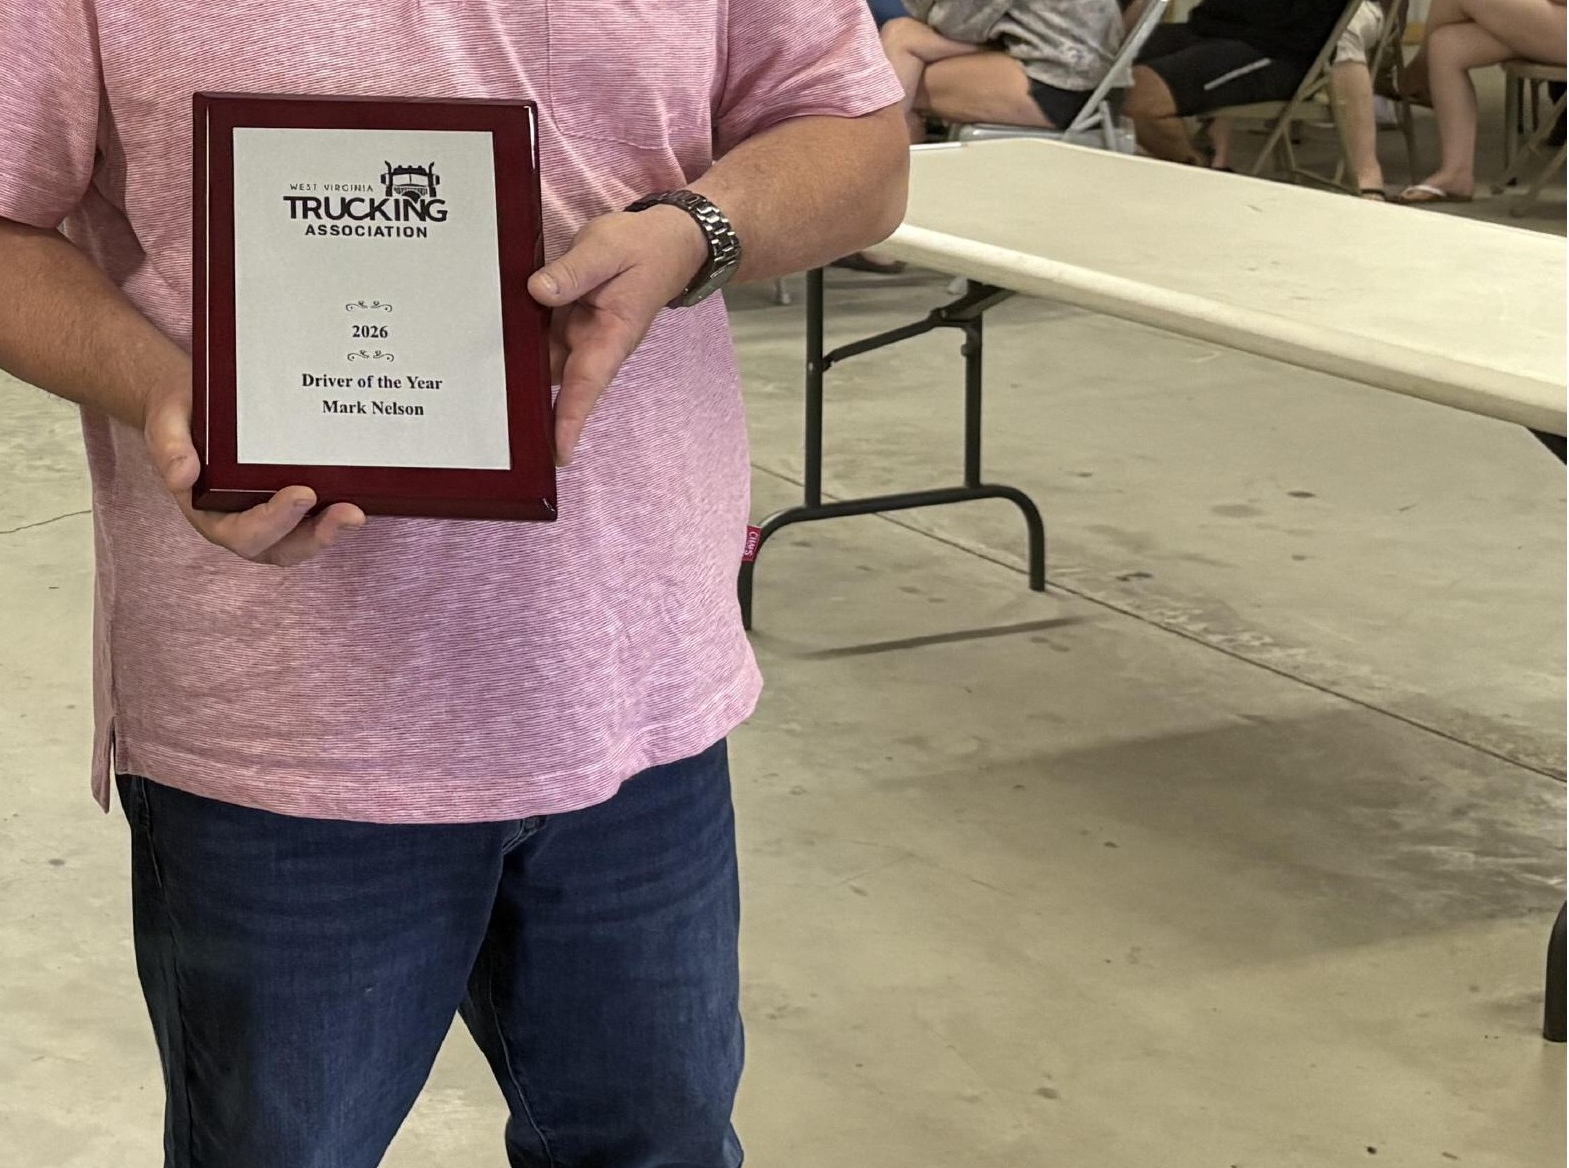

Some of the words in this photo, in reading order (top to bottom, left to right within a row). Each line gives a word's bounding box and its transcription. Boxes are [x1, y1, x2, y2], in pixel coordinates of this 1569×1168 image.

[289, 183, 317, 191] WEST
[323, 183, 374, 192] VIRGINIA
[282, 195, 449, 223] TRUCKING
[304, 224, 428, 239] ASSOCIATION
[352, 325, 388, 339] 2026
[302, 373, 353, 388] Driver
[357, 375, 374, 388] of
[377, 375, 402, 389] the
[406, 375, 443, 390] Year
[322, 400, 367, 415] Mark
[371, 401, 424, 416] Nelson
